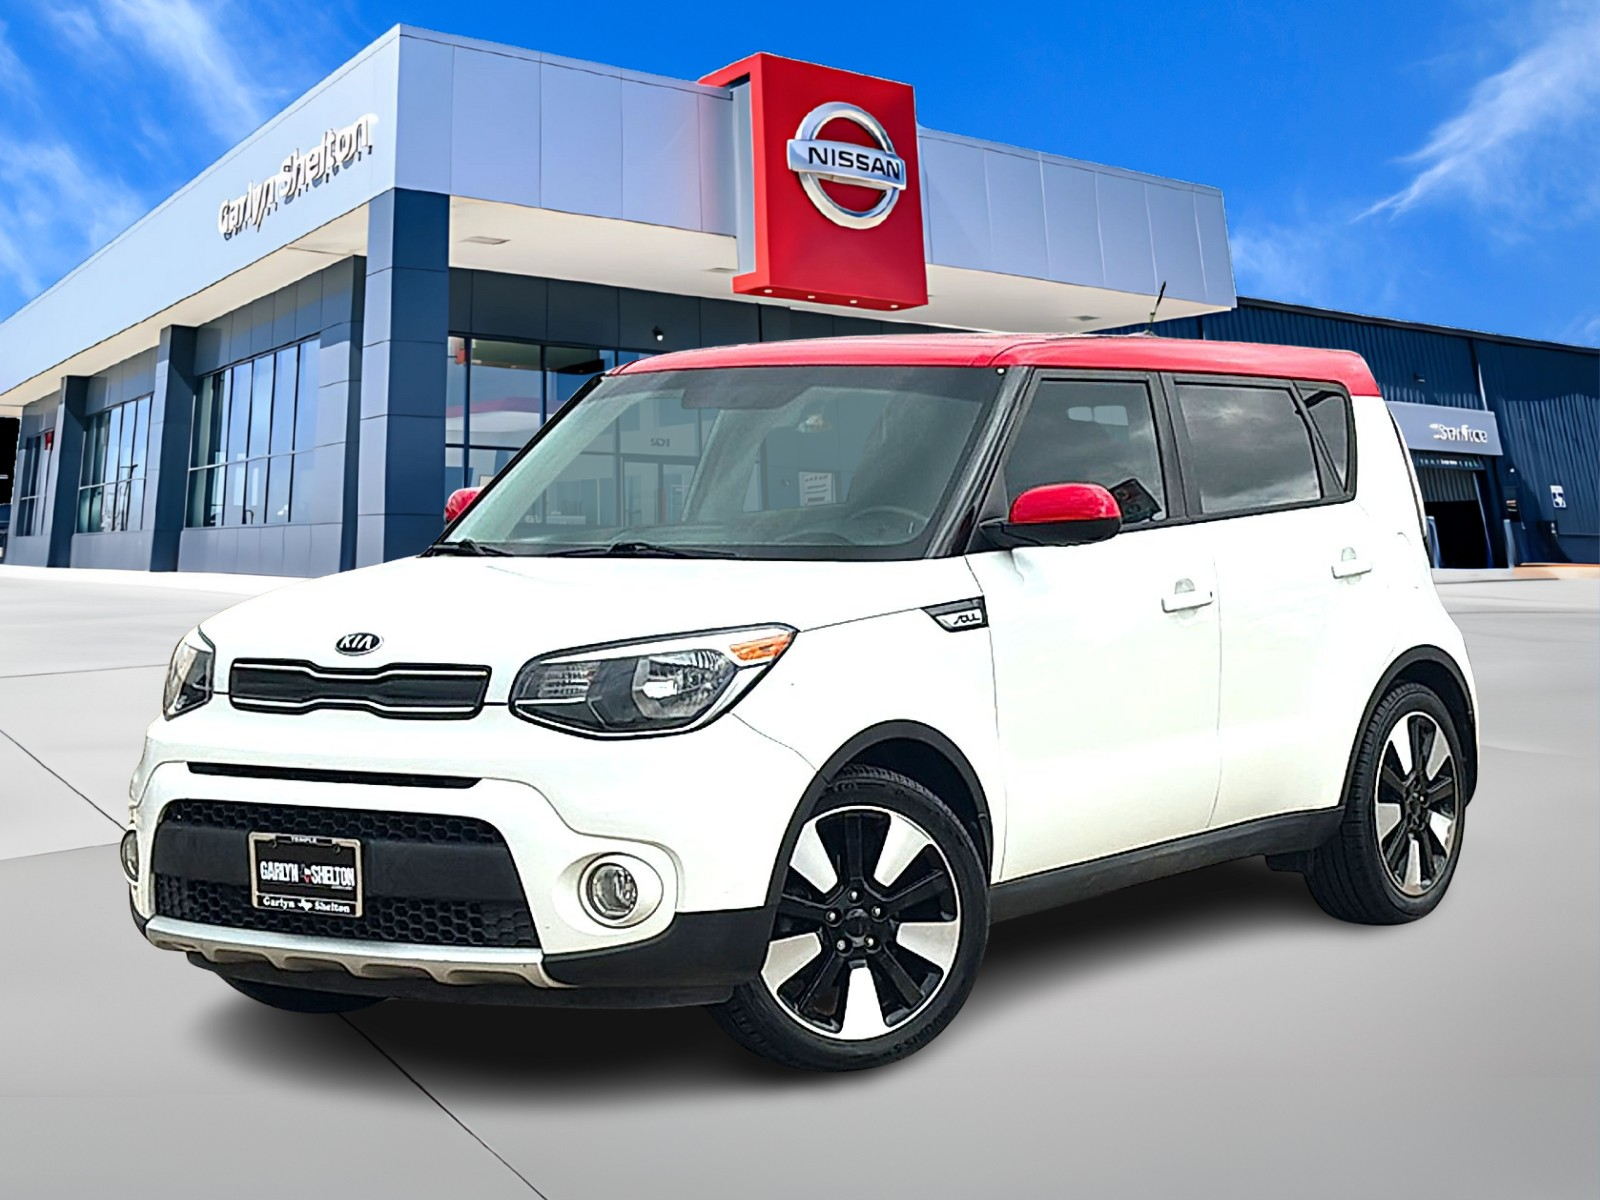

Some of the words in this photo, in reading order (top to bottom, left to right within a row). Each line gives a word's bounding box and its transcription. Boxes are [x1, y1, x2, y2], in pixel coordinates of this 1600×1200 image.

[277, 114, 372, 201] Shelton
[808, 147, 901, 181] NISSAN
[339, 633, 374, 650] KIA
[311, 865, 355, 887] SHELTON
[314, 900, 351, 914] Shelton
